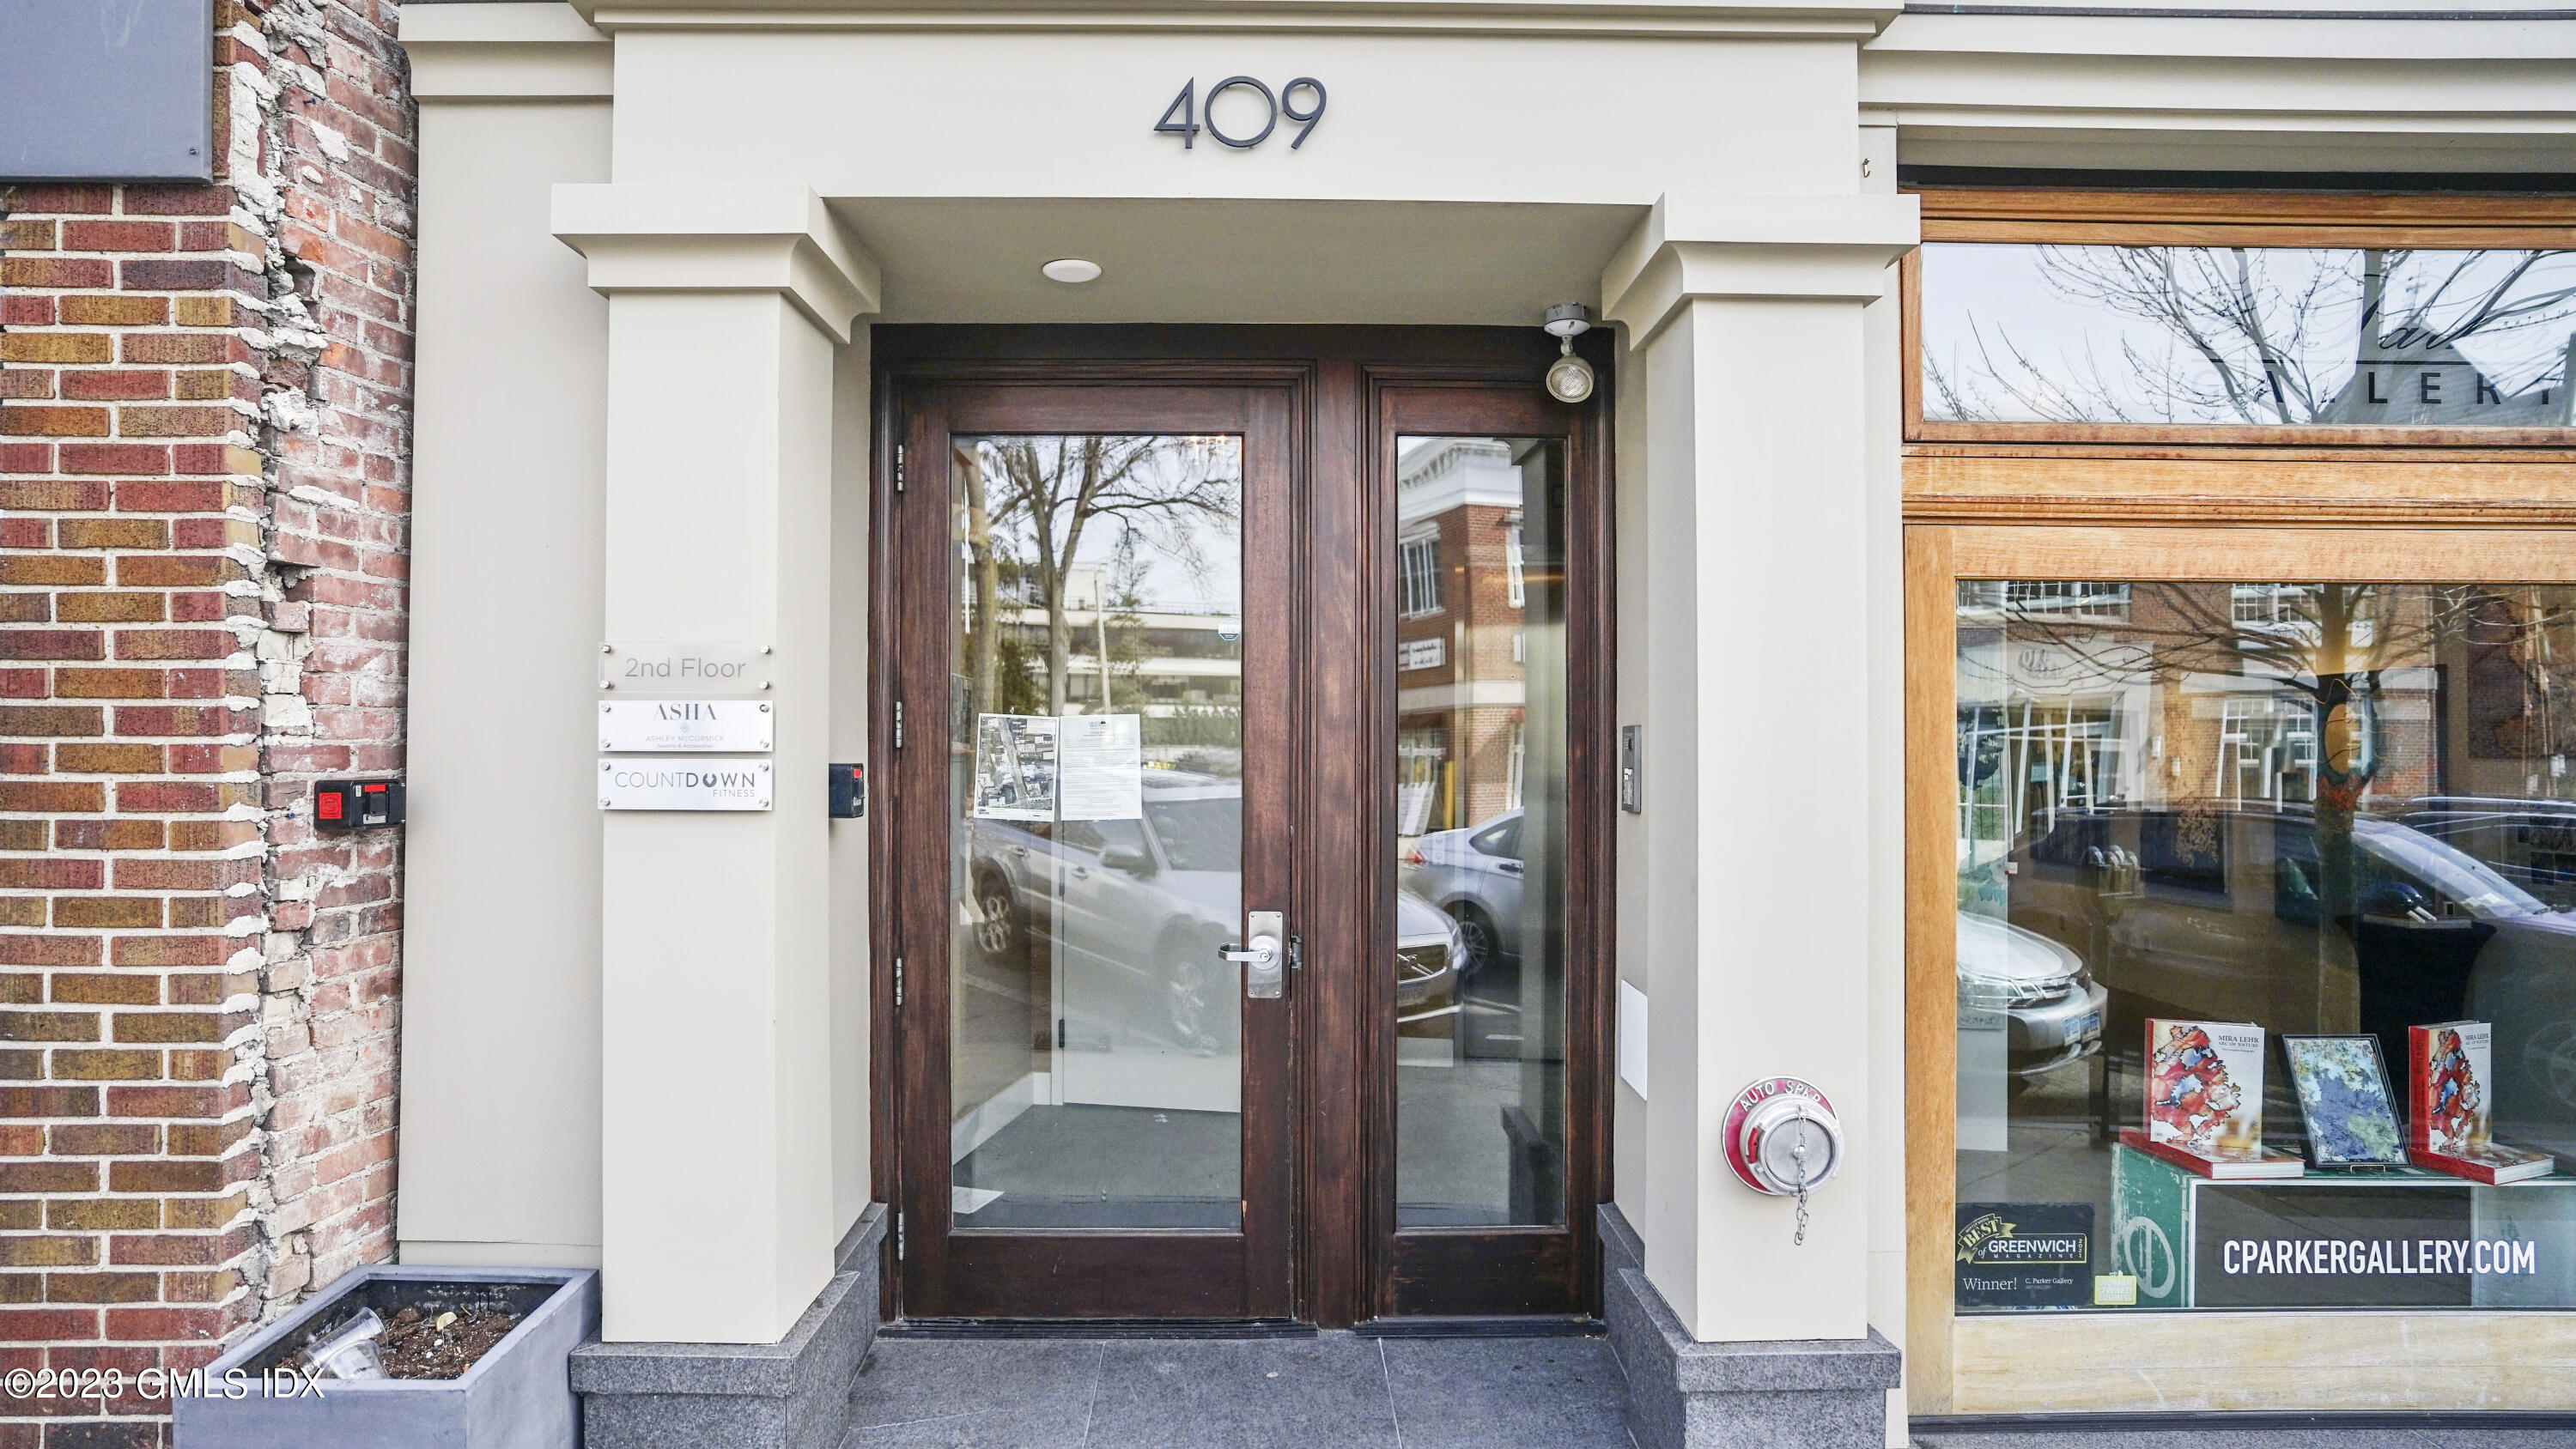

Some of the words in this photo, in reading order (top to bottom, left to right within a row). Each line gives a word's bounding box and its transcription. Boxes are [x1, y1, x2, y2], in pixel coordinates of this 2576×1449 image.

[1154, 76, 1327, 149] 409
[624, 658, 671, 677] 2nd
[681, 658, 745, 677] Floor
[653, 703, 716, 720] ASHA
[615, 772, 755, 788] COUNTDOWN
[1740, 1082, 1775, 1113] AUTO
[1963, 1219, 1999, 1248] BEST
[1978, 1246, 1988, 1258] of
[1989, 1240, 2076, 1252] GREENWICH
[2223, 1240, 2536, 1274] CPARKERGALLERY.COM
[1963, 1277, 2017, 1291] Winner!
